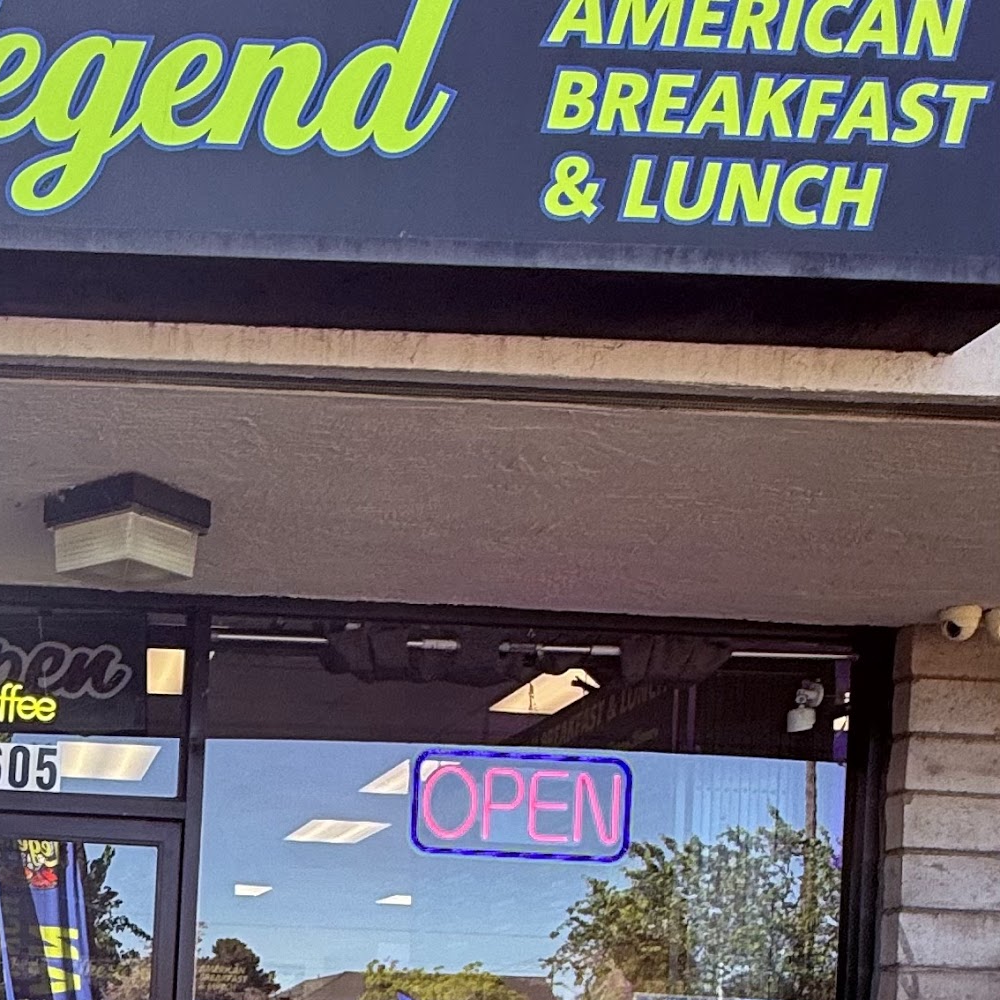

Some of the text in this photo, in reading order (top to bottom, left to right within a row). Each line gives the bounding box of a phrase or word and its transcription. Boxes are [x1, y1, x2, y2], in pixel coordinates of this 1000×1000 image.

[547, 0, 965, 57] AMERICAN
[546, 70, 988, 144] BREAKFAST
[544, 156, 882, 227] & LUNCH
[423, 764, 622, 845] OPEN
